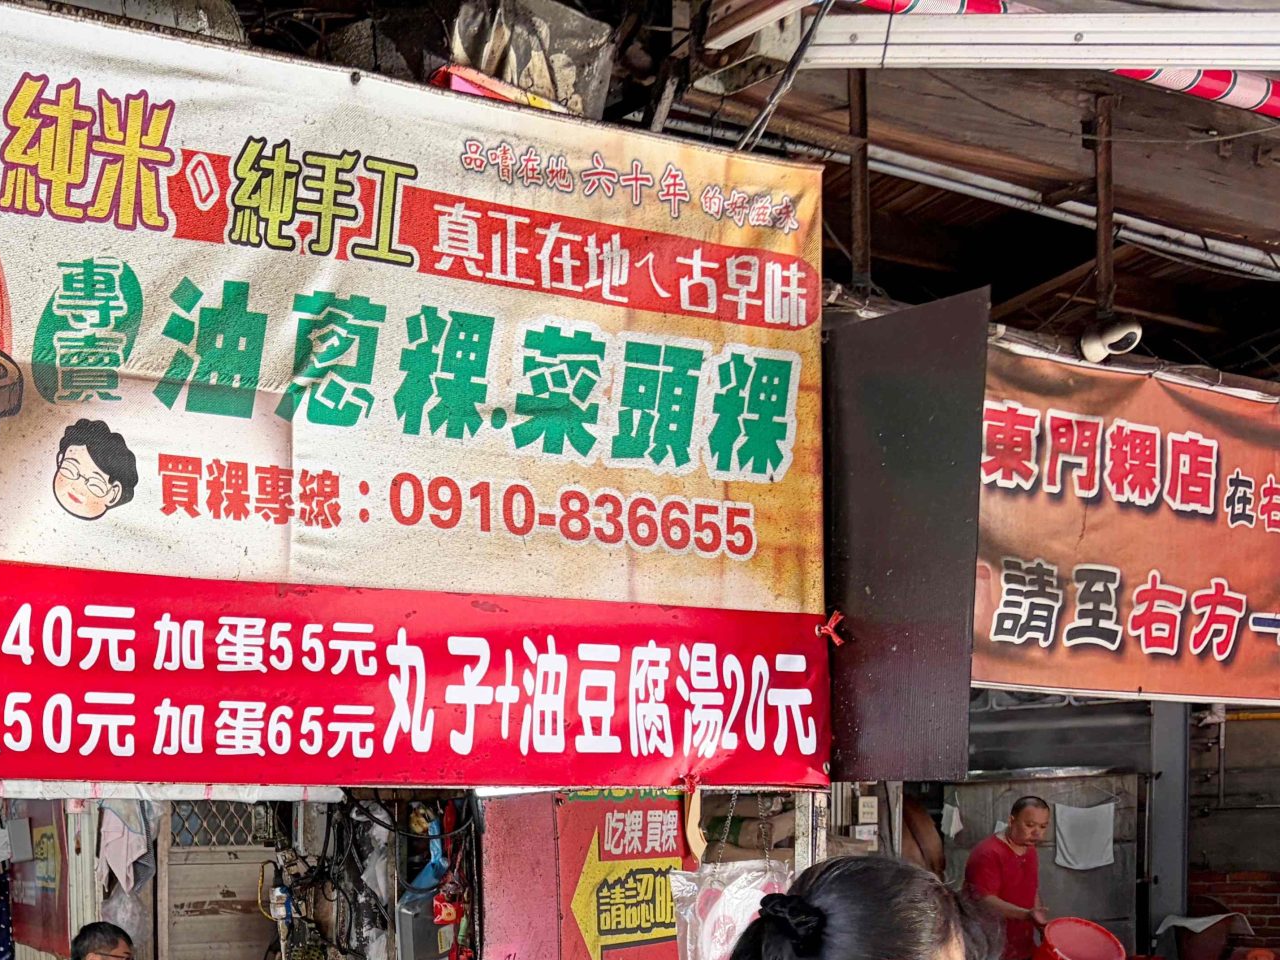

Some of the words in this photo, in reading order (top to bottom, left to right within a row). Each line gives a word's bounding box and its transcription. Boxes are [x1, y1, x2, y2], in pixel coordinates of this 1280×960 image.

[0, 72, 174, 231] 純米
[228, 137, 418, 268] 純手工
[582, 153, 690, 218] 六十年
[700, 185, 800, 235] 的好滋味
[54, 257, 127, 402] 專賣
[981, 401, 1218, 514] 東門粿店
[383, 627, 816, 759] 丸子+油豆腐湯20元
